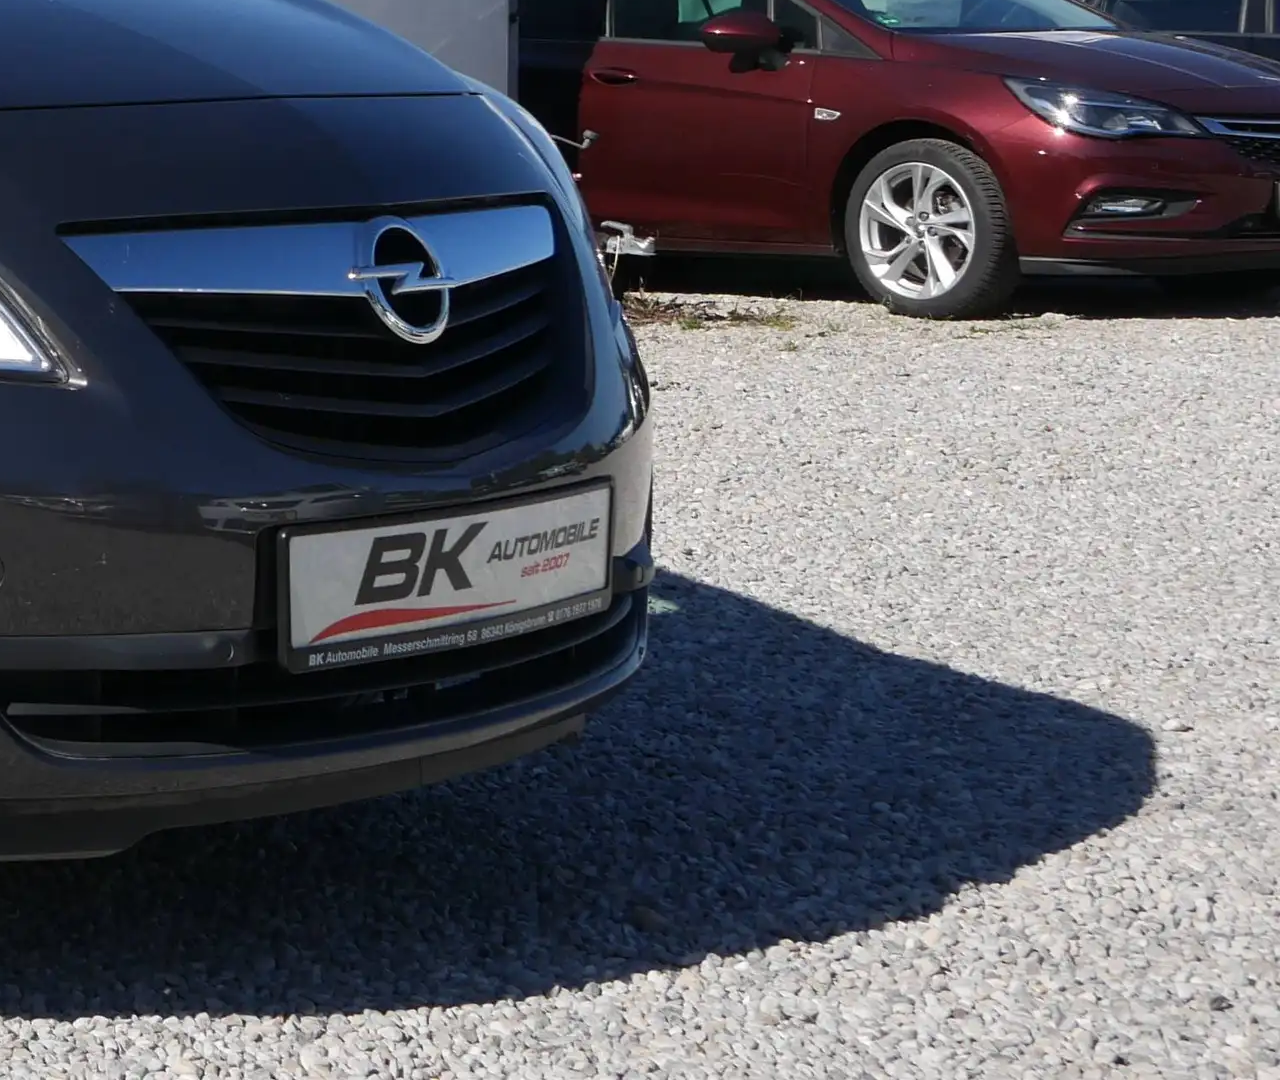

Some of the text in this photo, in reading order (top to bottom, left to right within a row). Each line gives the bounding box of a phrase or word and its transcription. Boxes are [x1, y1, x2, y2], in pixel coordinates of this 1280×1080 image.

[354, 517, 600, 607] BK AUTOMOBILE
[308, 652, 324, 667] BK
[325, 645, 379, 664] Automobile
[383, 632, 465, 655] Messerschmittring
